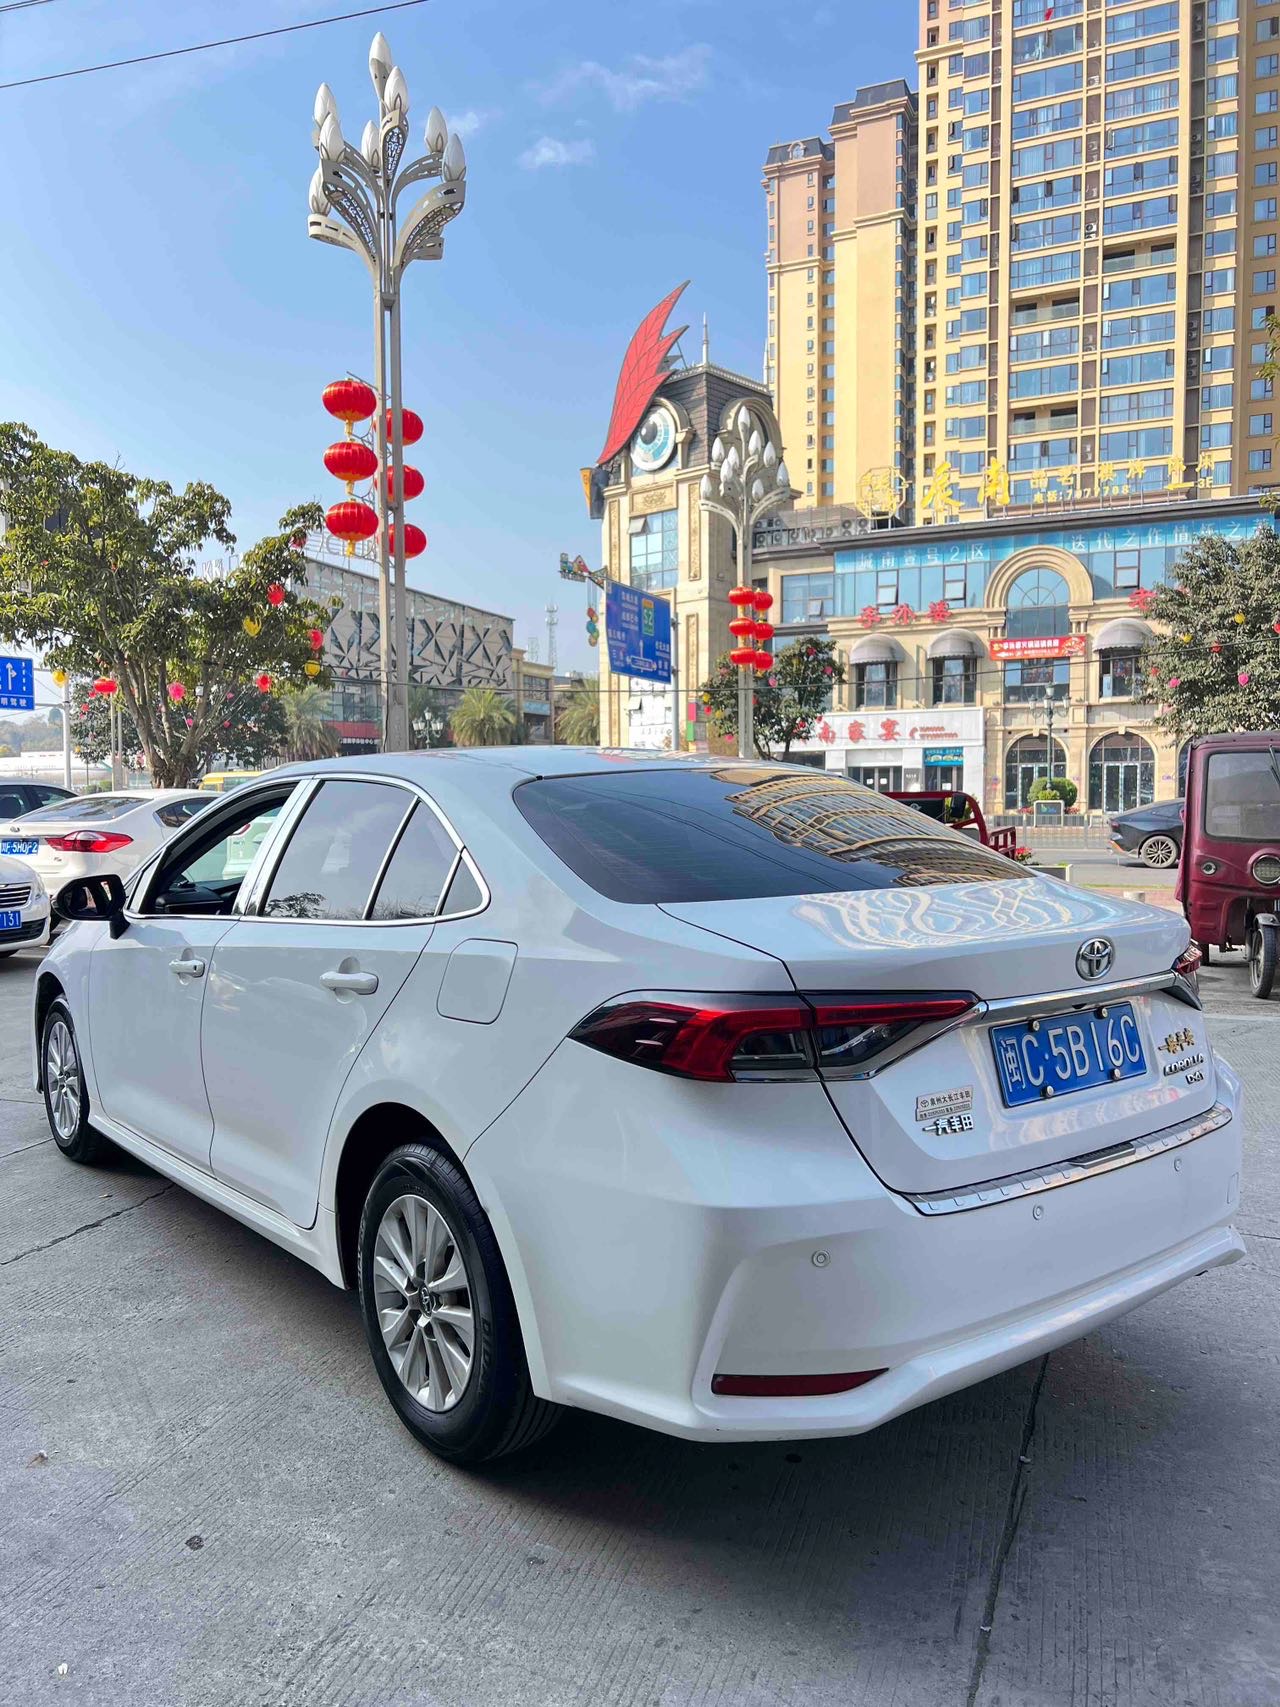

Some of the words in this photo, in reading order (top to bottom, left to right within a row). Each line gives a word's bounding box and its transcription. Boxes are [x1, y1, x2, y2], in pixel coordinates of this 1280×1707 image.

[802, 717, 902, 745] 南家宴
[0, 911, 20, 927] 131
[1163, 1053, 1204, 1077] COROLLA
[922, 1114, 974, 1136] 一汽丰田
